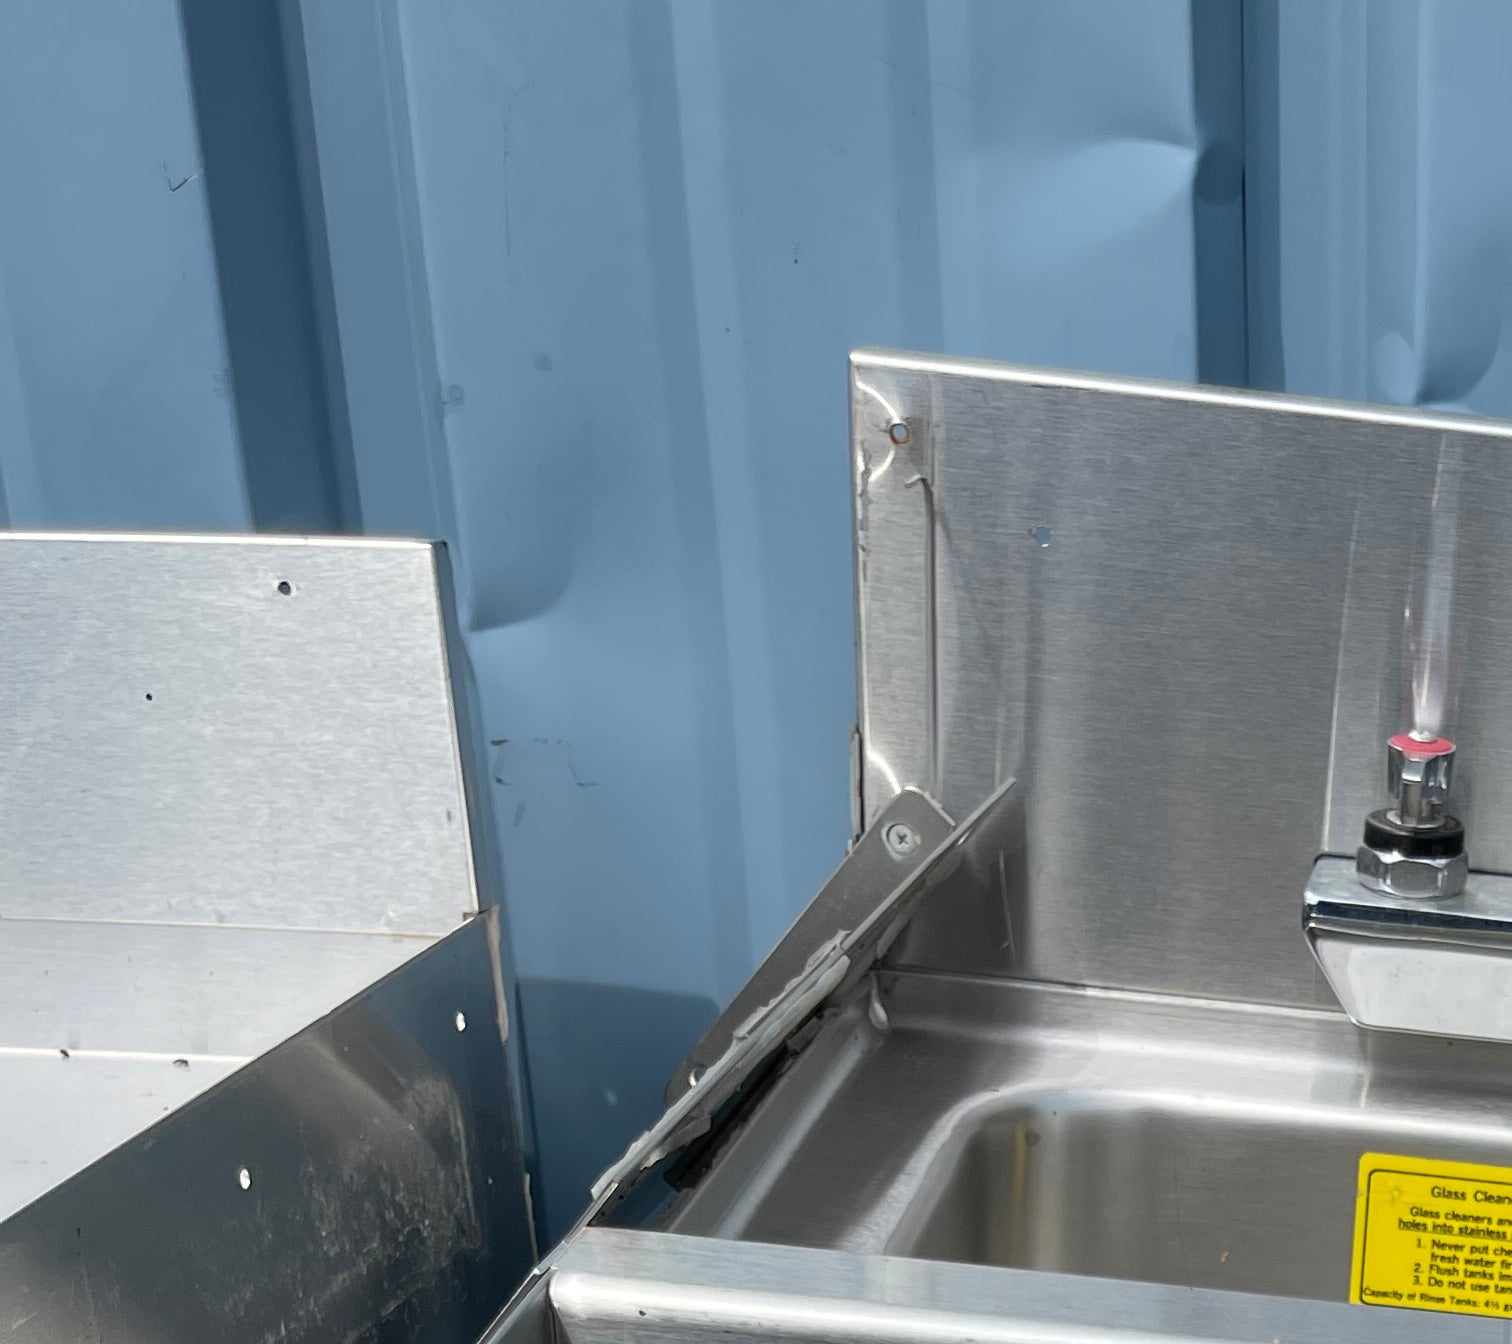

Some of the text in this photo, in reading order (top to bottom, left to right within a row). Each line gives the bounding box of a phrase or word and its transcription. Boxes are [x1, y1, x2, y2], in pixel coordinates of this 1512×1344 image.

[1431, 1186, 1466, 1200] Glass
[1410, 1207, 1440, 1219] Glass
[1445, 1211, 1492, 1225] cleaners
[1399, 1217, 1427, 1231] holes
[1432, 1222, 1454, 1234] into
[1459, 1225, 1507, 1239] stainless
[1416, 1238, 1426, 1248] 1.
[1431, 1239, 1465, 1251] Never
[1470, 1245, 1489, 1255] put
[1431, 1253, 1459, 1264] fresh
[1464, 1258, 1496, 1268] water
[1414, 1263, 1424, 1273] 2.
[1429, 1264, 1459, 1276] Flush
[1464, 1269, 1494, 1280] tanks
[1413, 1276, 1422, 1286] 3.
[1428, 1277, 1443, 1287] Do
[1448, 1280, 1466, 1290] not
[1471, 1284, 1490, 1292] use
[1364, 1287, 1403, 1301] Capacity
[1407, 1292, 1416, 1300] of
[1420, 1293, 1445, 1303] Rinse
